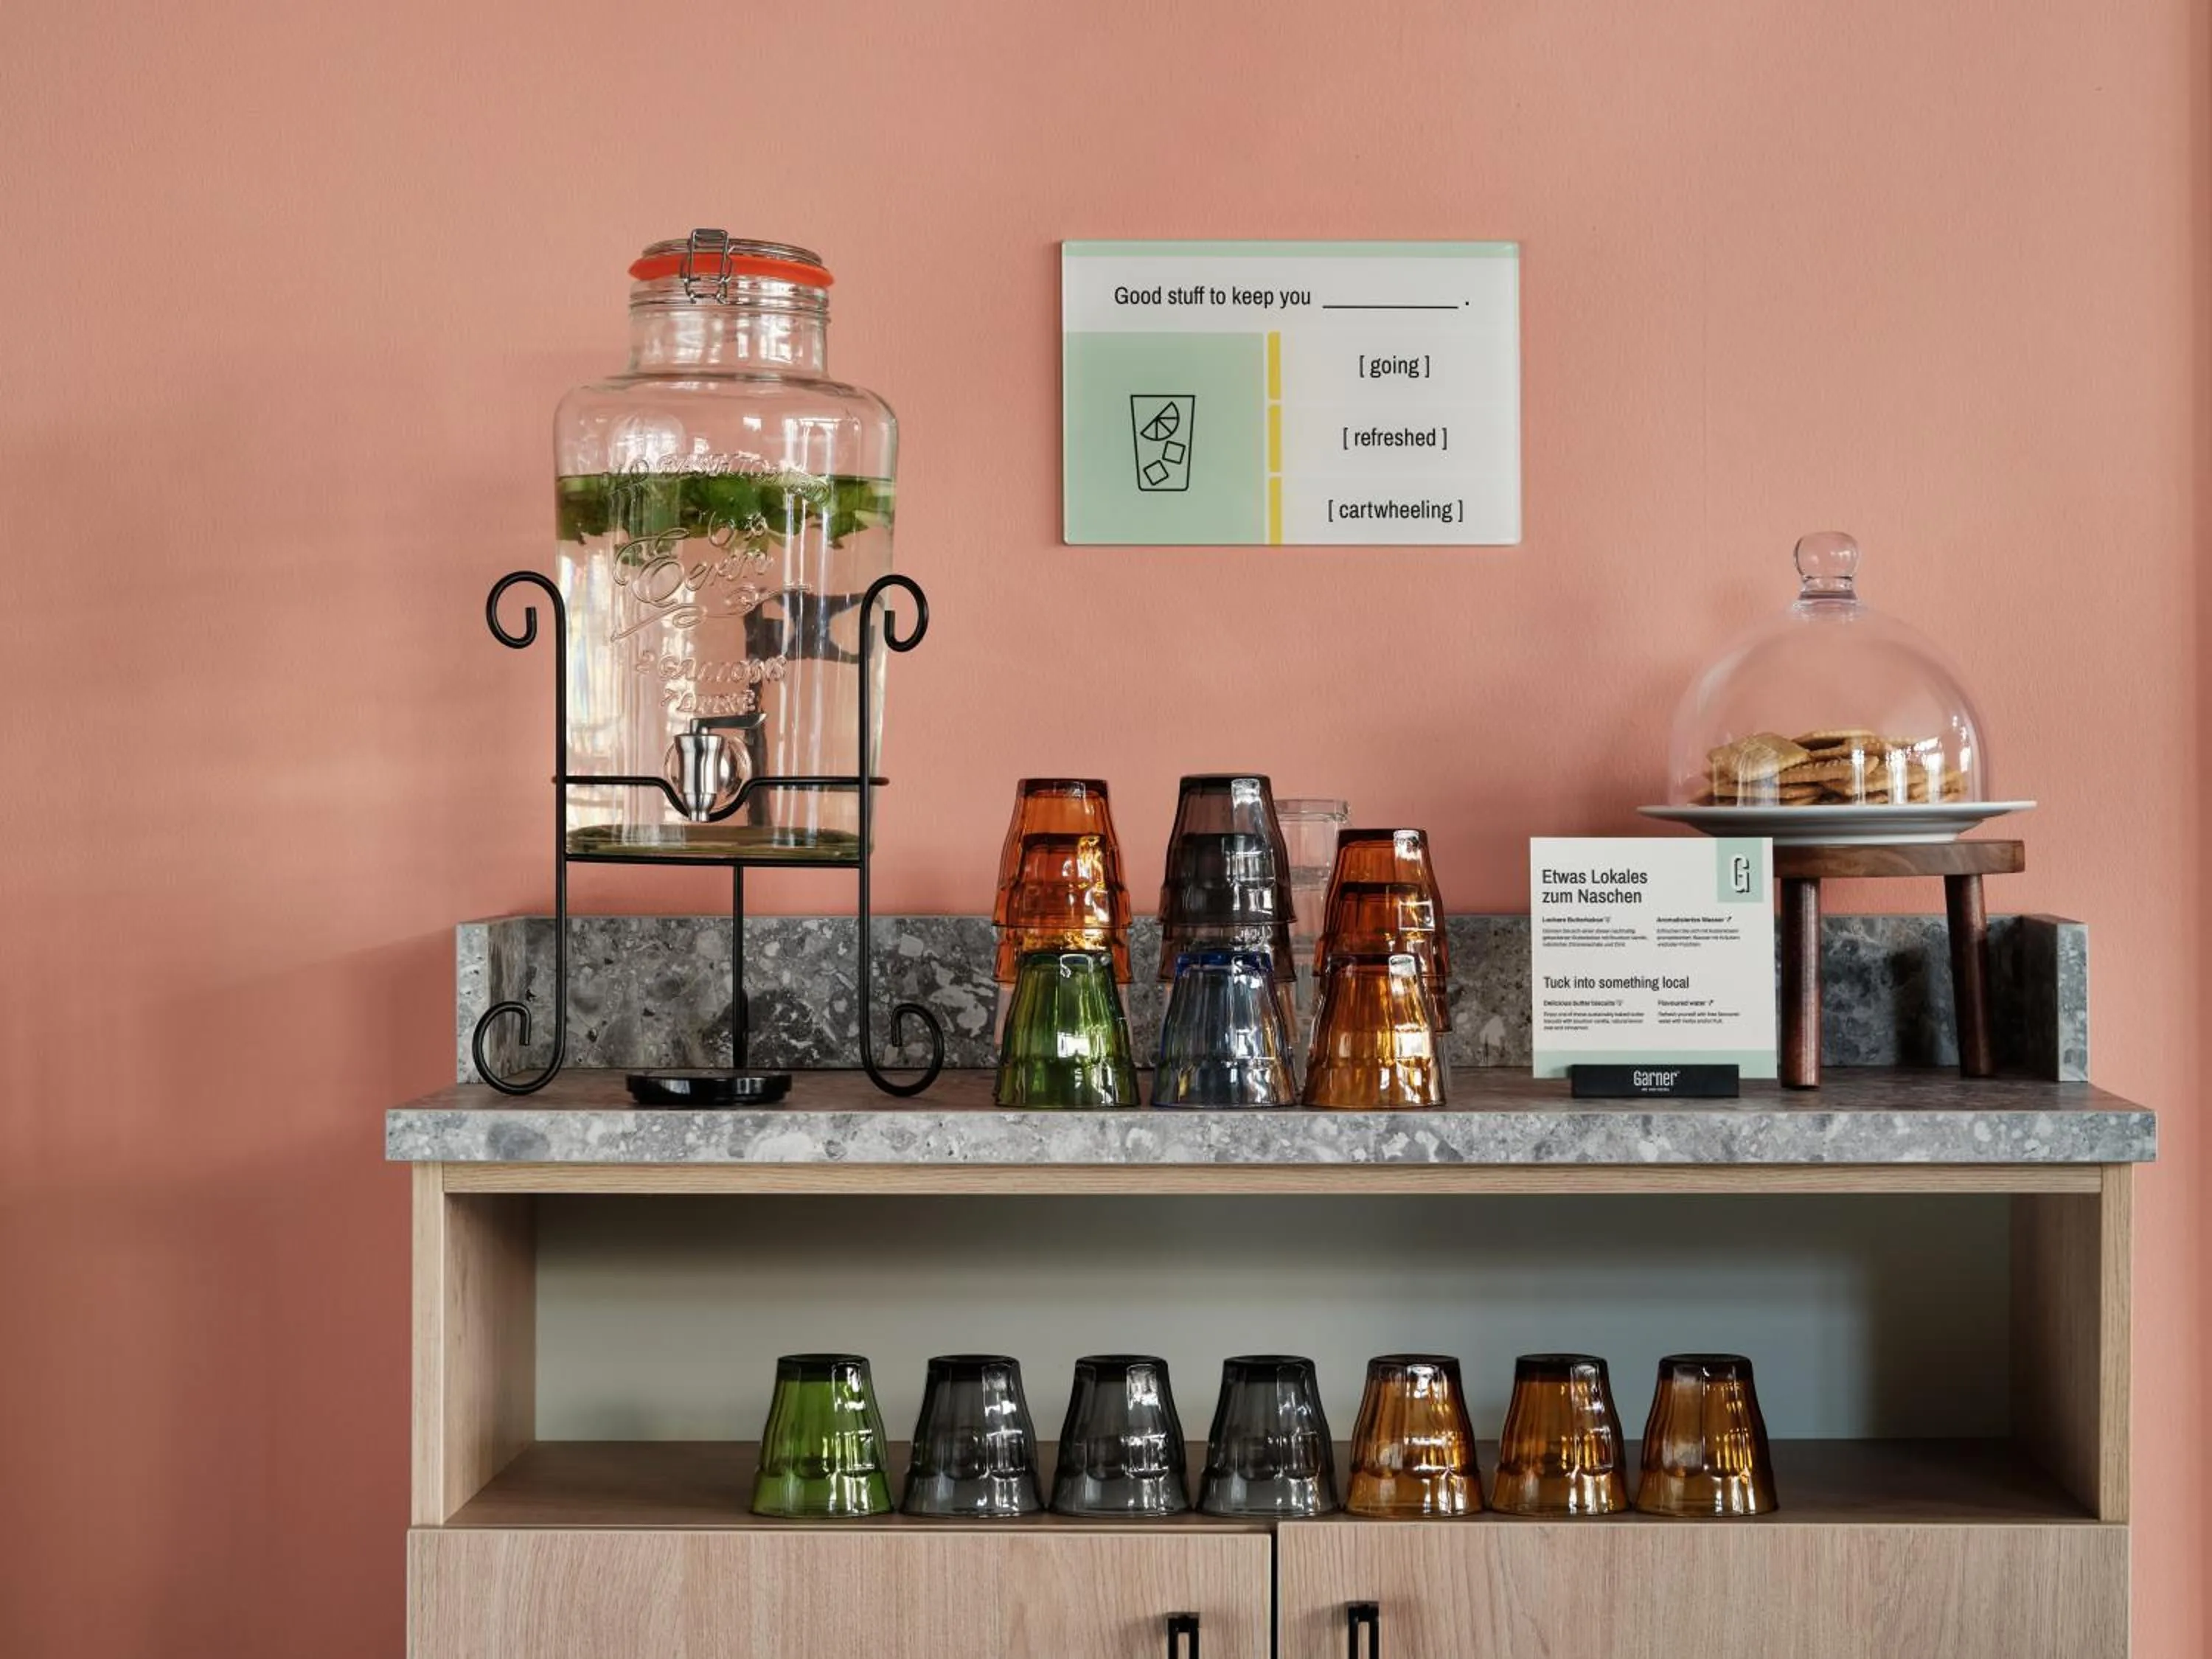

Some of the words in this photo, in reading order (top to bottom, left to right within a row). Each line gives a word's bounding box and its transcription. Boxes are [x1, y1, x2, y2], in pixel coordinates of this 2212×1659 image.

[1114, 285, 1162, 305] Good
[1167, 285, 1206, 305] stuff
[1209, 287, 1226, 305] to
[1232, 286, 1274, 309] keep
[1279, 290, 1311, 310] you
[1542, 869, 1587, 884] Etwas
[1591, 869, 1648, 884] Lokales
[1542, 891, 1573, 904] zum
[1578, 888, 1642, 904] Naschen
[1543, 976, 1571, 989] Tuck
[1573, 976, 1596, 989] into
[1599, 976, 1660, 992] something
[1662, 976, 1689, 989] local
[1633, 1070, 1676, 1086] Garner
